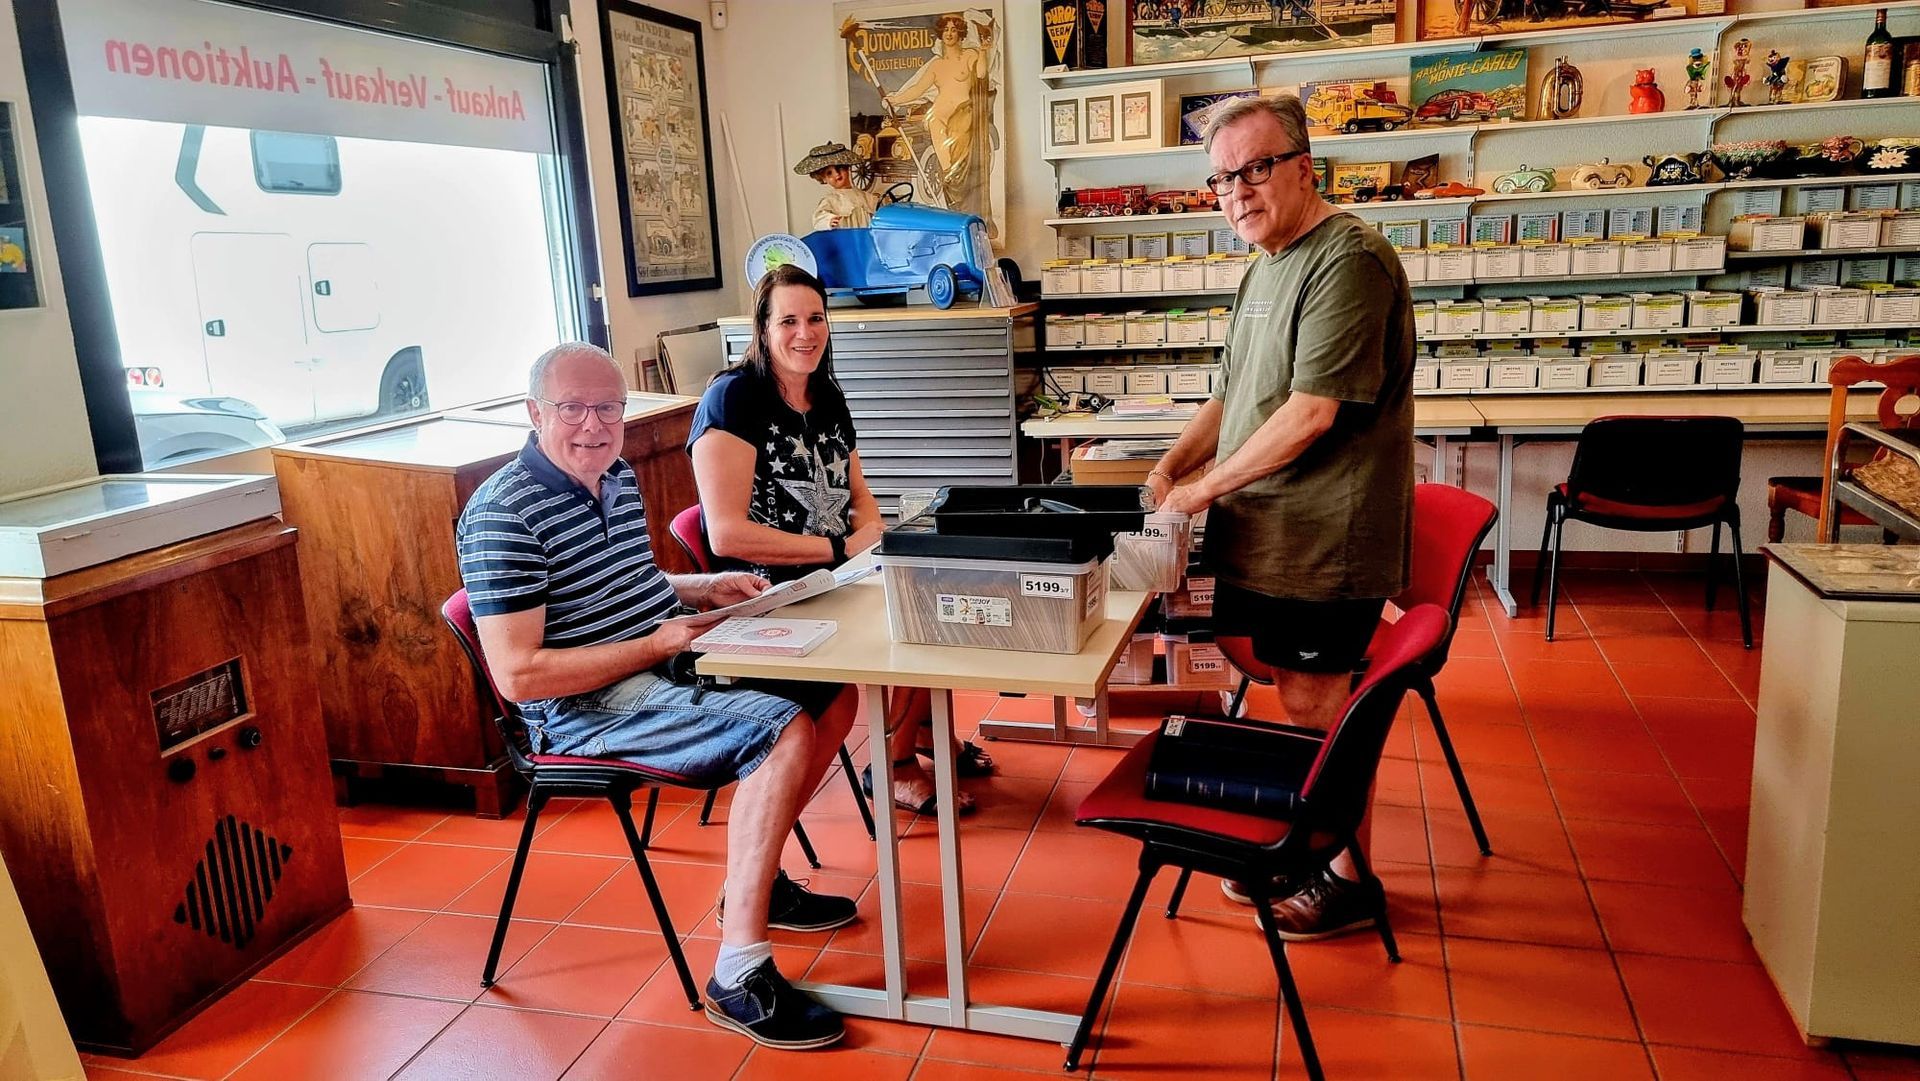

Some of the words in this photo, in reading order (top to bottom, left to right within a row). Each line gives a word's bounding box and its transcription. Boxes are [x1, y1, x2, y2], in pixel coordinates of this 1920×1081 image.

[1045, 5, 1076, 26] DUROL
[635, 21, 671, 39] KINDER
[1049, 26, 1072, 37] GERM
[1053, 38, 1066, 48] OIL
[865, 57, 924, 76] AUSSTELLUNG
[1429, 51, 1524, 84] MONTE-CARLO
[1025, 580, 1060, 592] 5199
